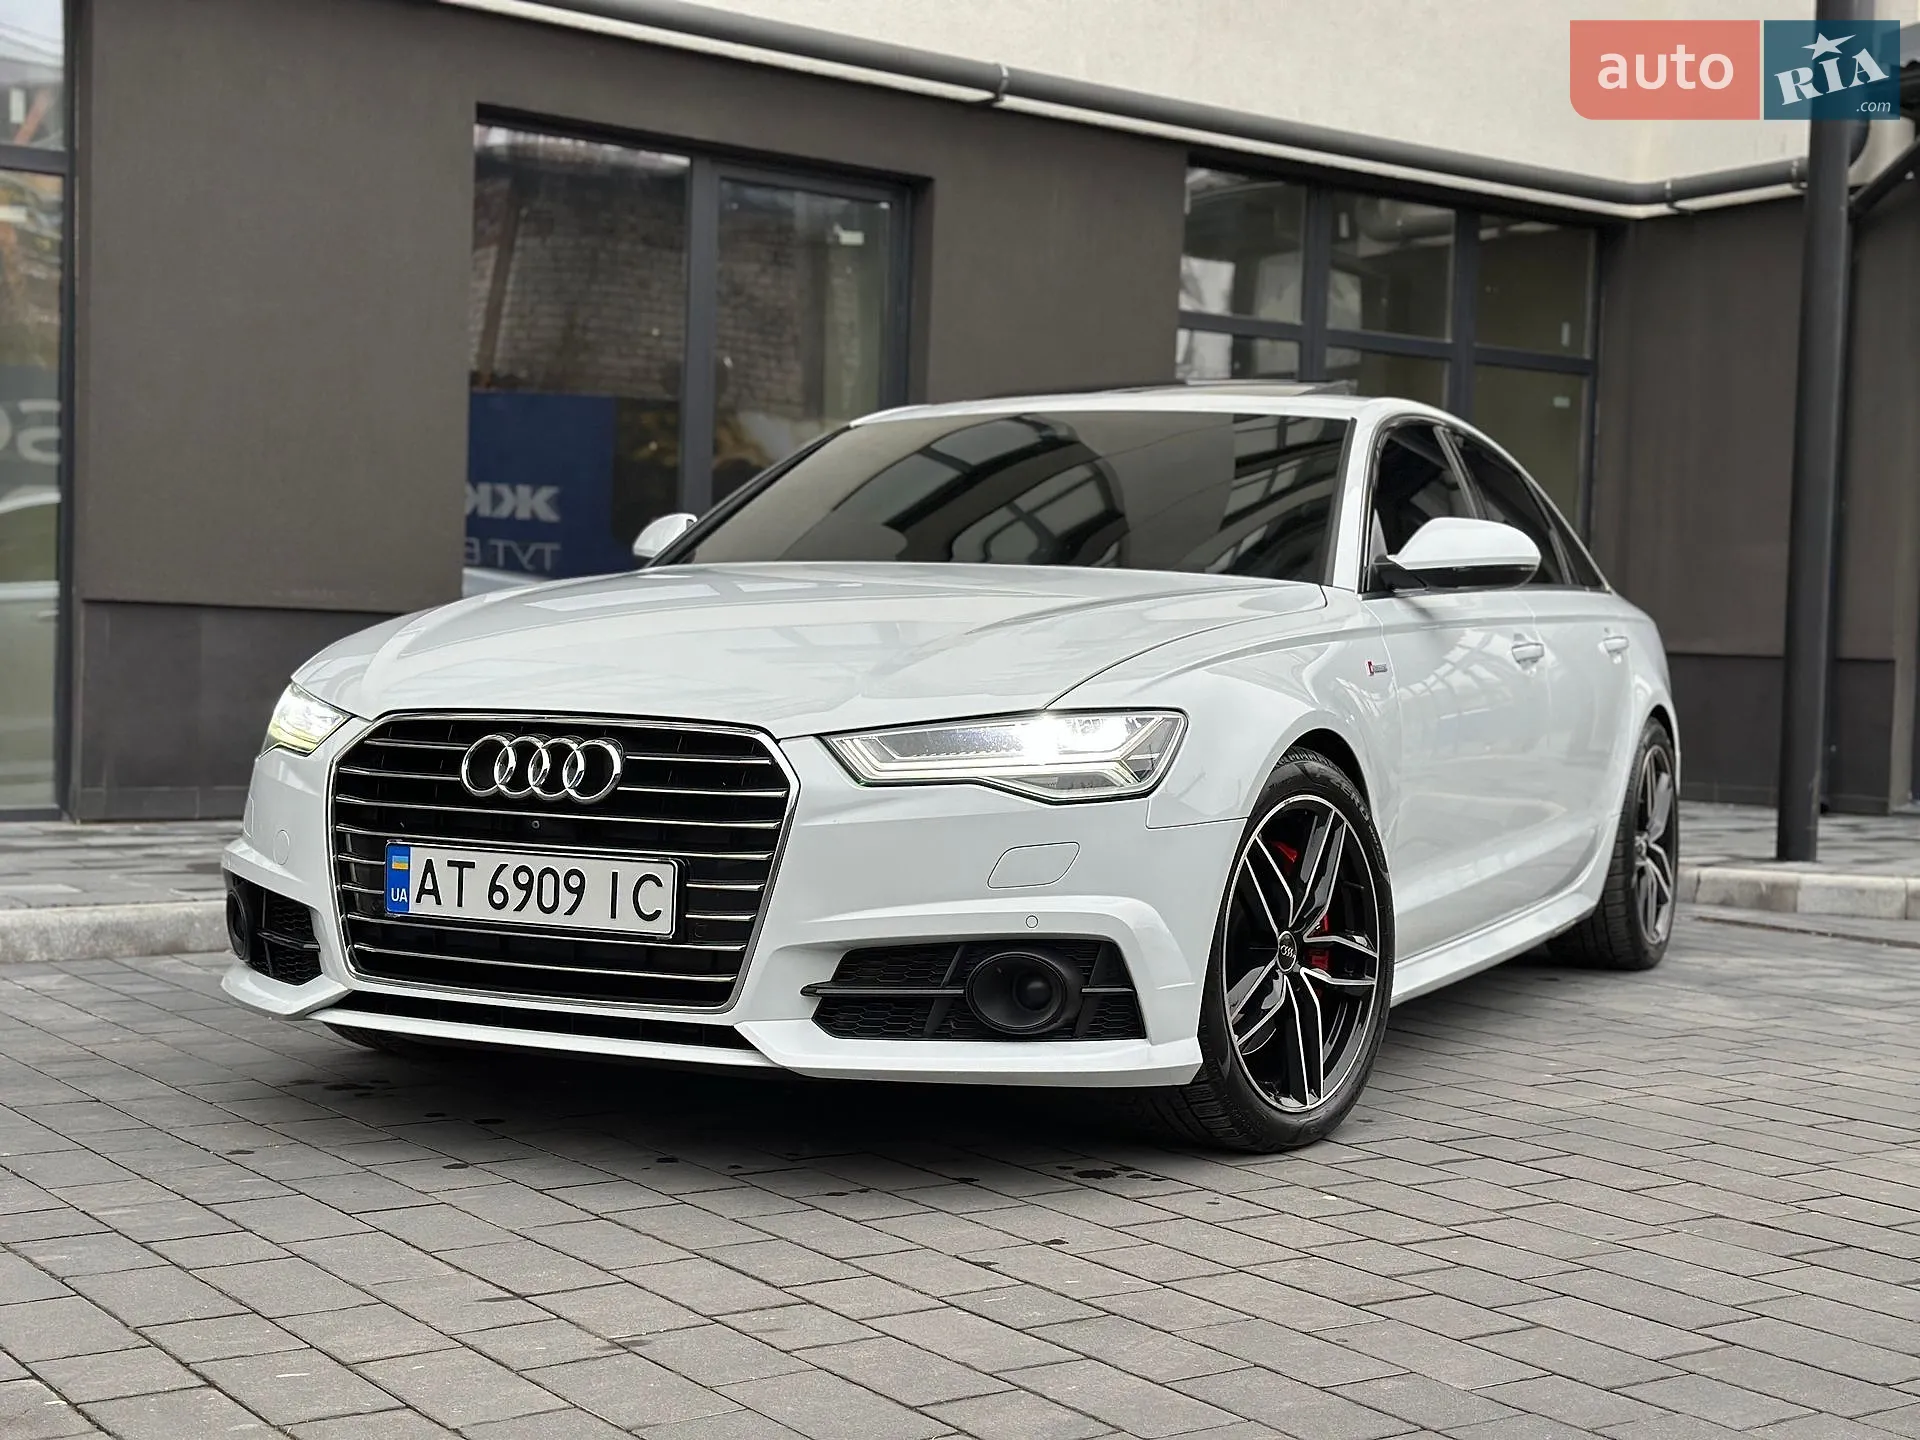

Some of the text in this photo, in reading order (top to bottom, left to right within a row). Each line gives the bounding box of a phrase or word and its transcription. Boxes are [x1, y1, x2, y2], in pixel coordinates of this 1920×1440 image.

[391, 887, 408, 903] UA
[415, 858, 664, 922] AT 6909 IC
